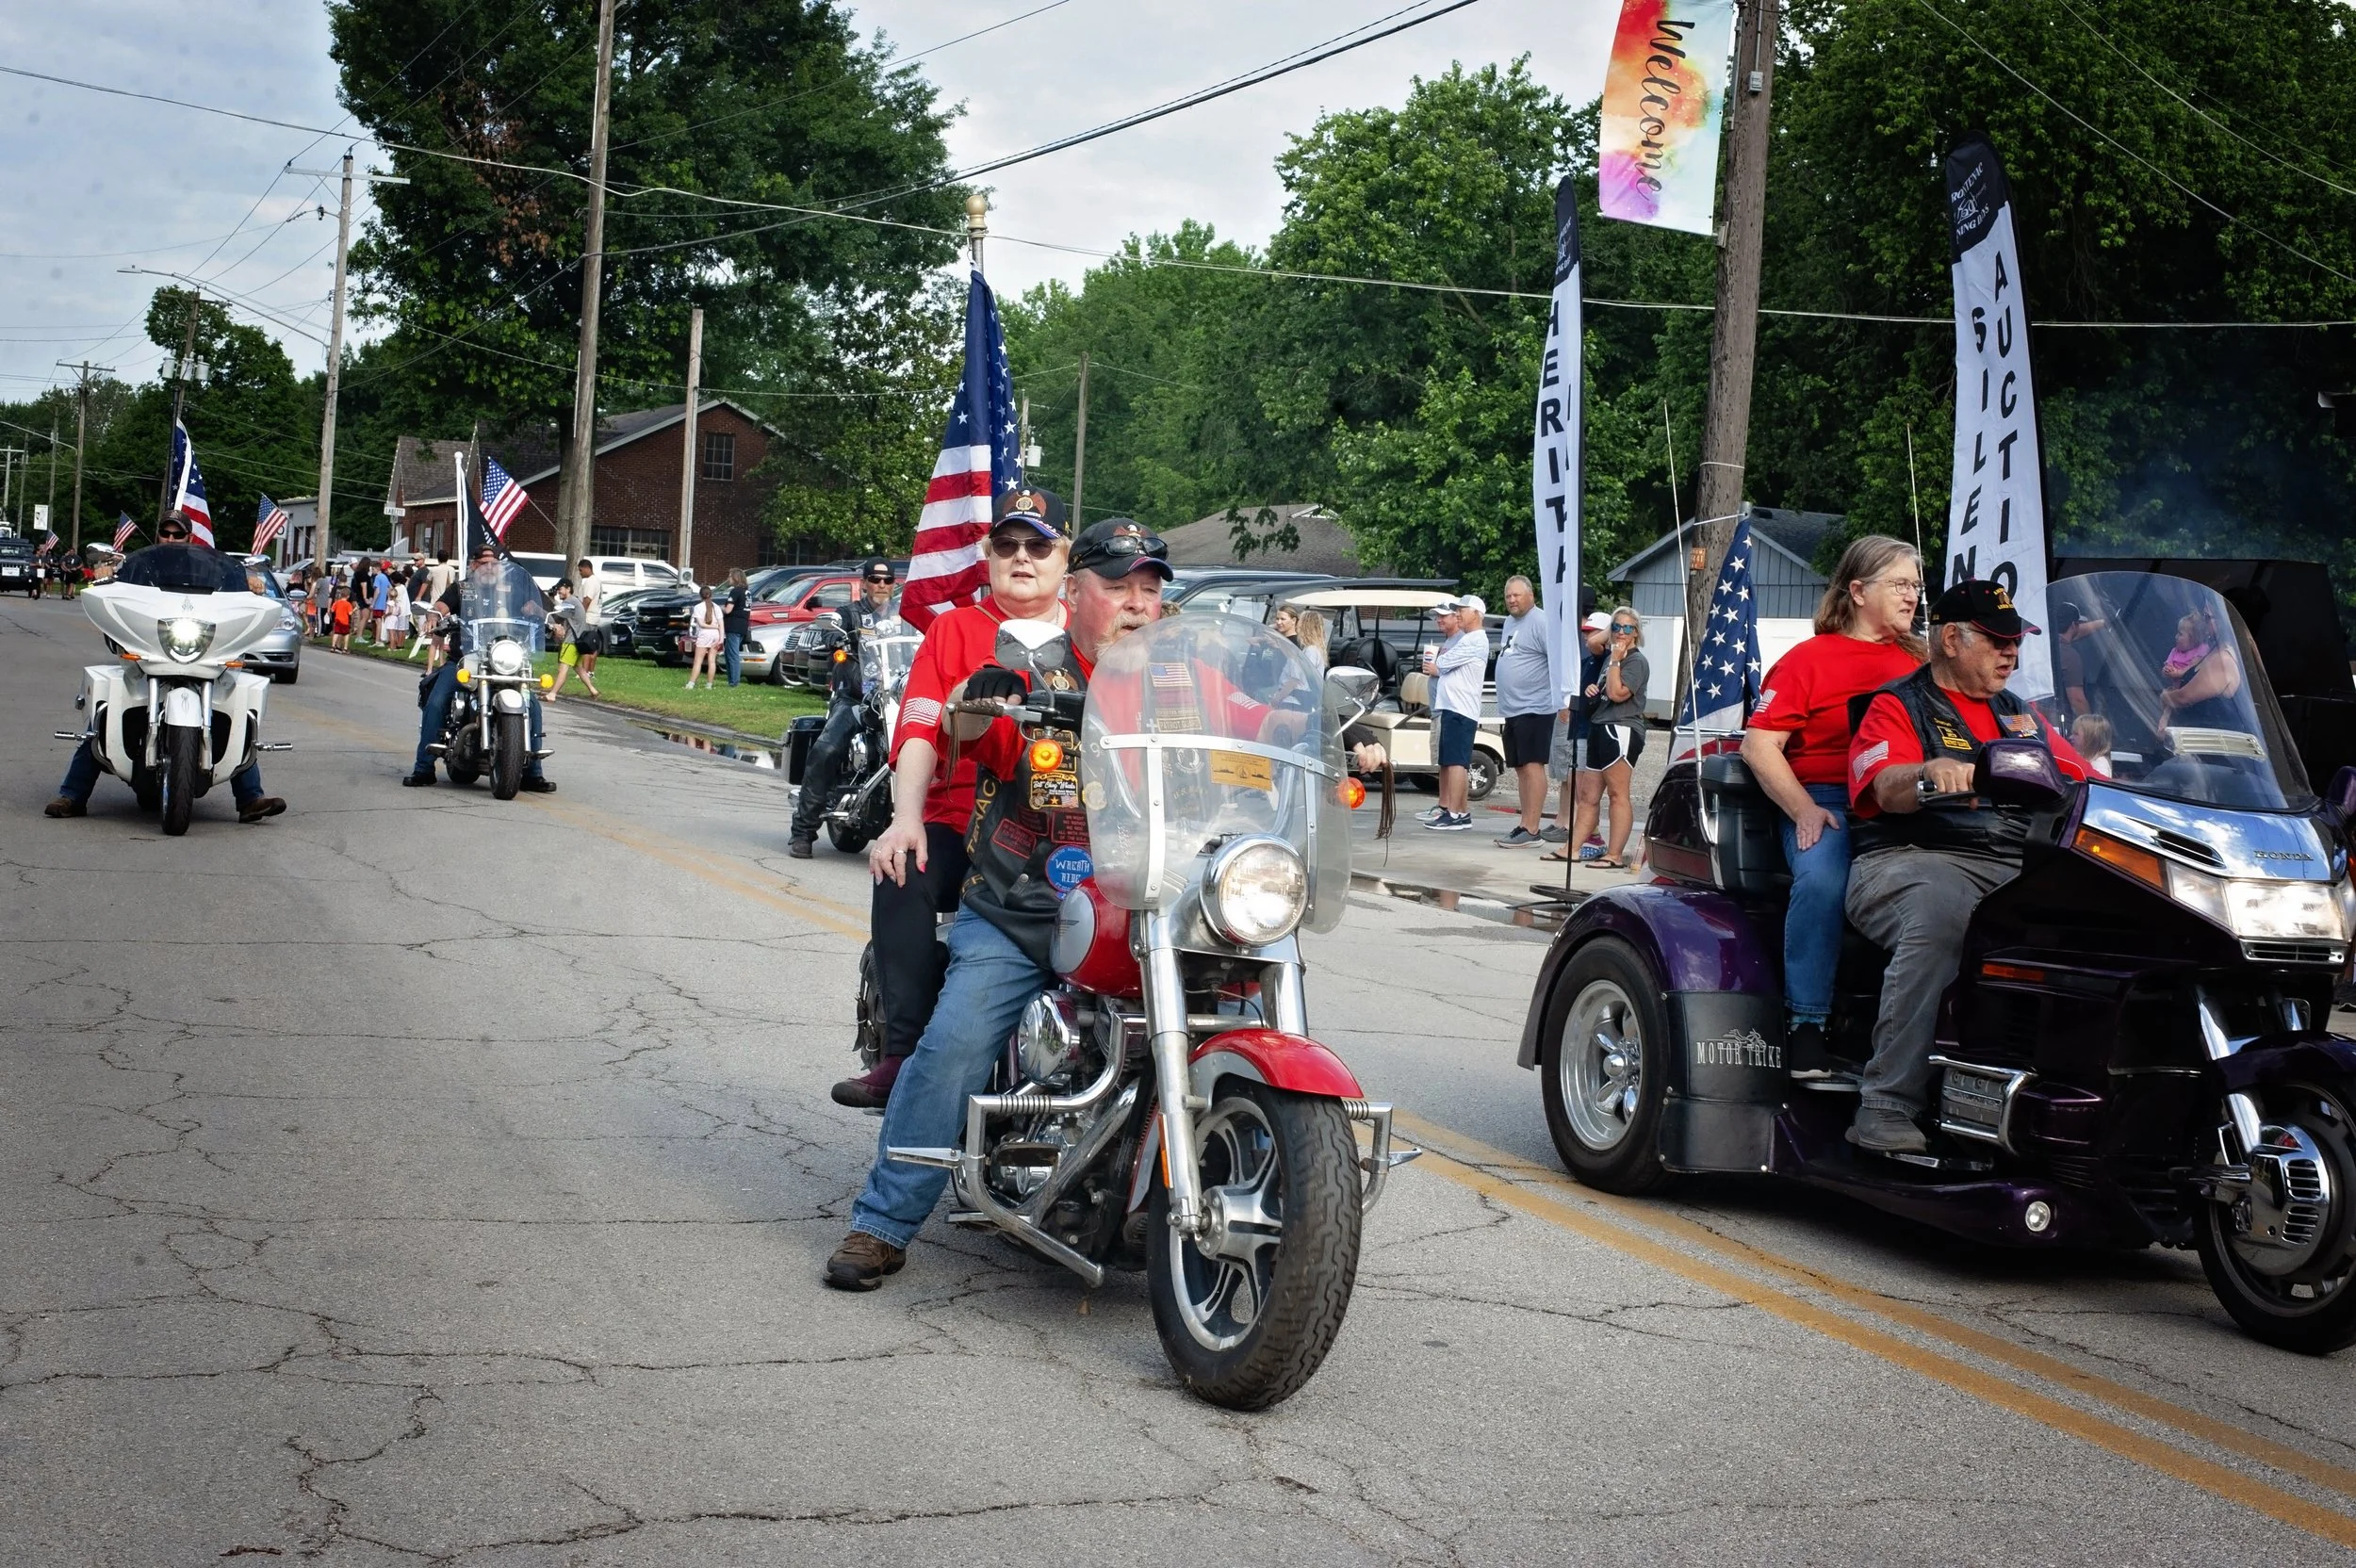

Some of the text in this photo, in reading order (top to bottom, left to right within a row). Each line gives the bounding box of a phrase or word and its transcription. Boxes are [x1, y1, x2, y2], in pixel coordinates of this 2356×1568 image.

[1634, 20, 1695, 201] Welcome
[1952, 306, 1988, 587] SILEN
[1988, 250, 2019, 603] AUCTIO
[1159, 720, 1181, 729] PATRIOT
[2253, 850, 2315, 861] HONDA
[1696, 1041, 1782, 1069] MOTOR TRIKE
